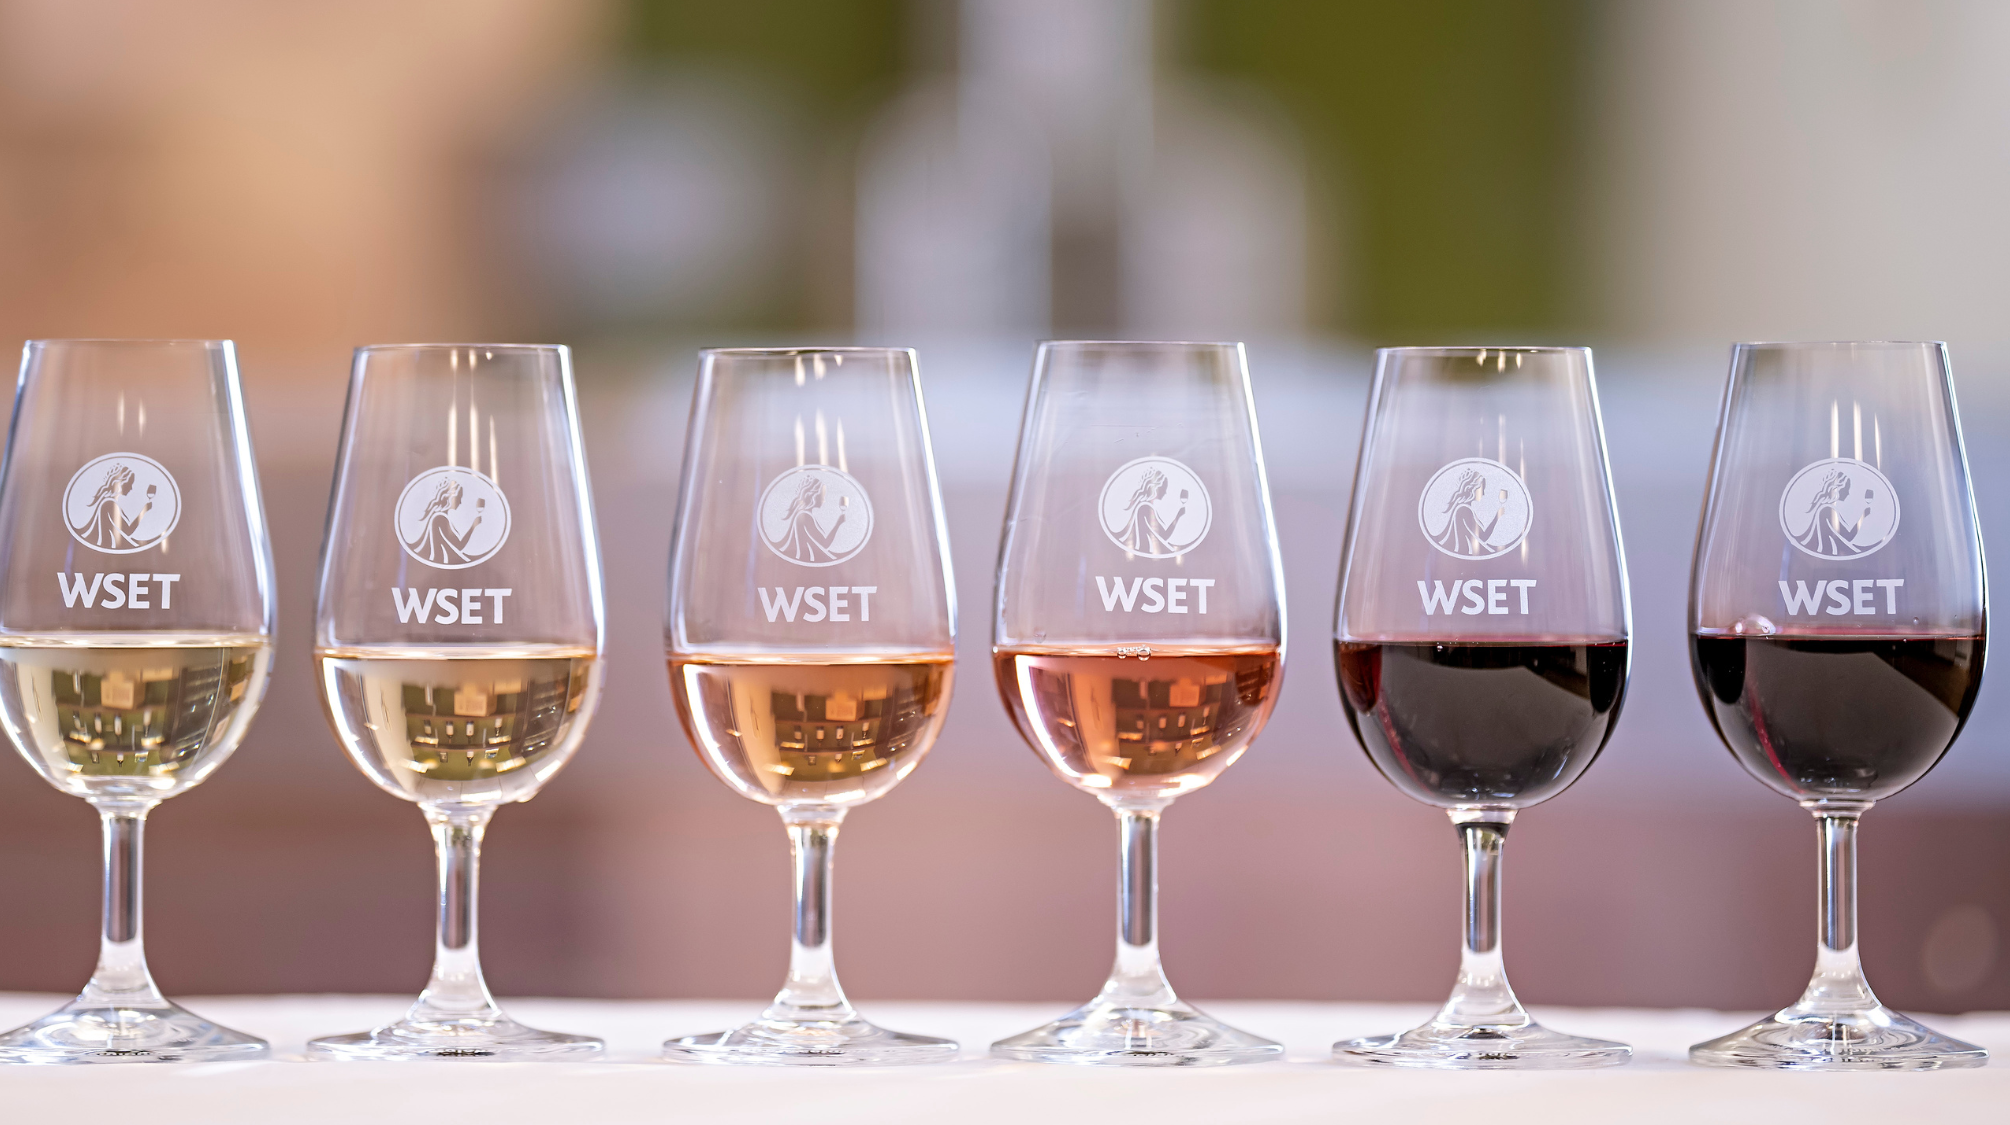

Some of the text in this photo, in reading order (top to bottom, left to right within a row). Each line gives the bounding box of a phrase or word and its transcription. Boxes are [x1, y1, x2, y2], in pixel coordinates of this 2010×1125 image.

[57, 572, 180, 609] WSET
[391, 587, 512, 624] WSET
[758, 586, 877, 622] WSET
[1096, 576, 1215, 614] WSET
[1417, 579, 1536, 615] WSET
[1778, 579, 1904, 615] WSET
